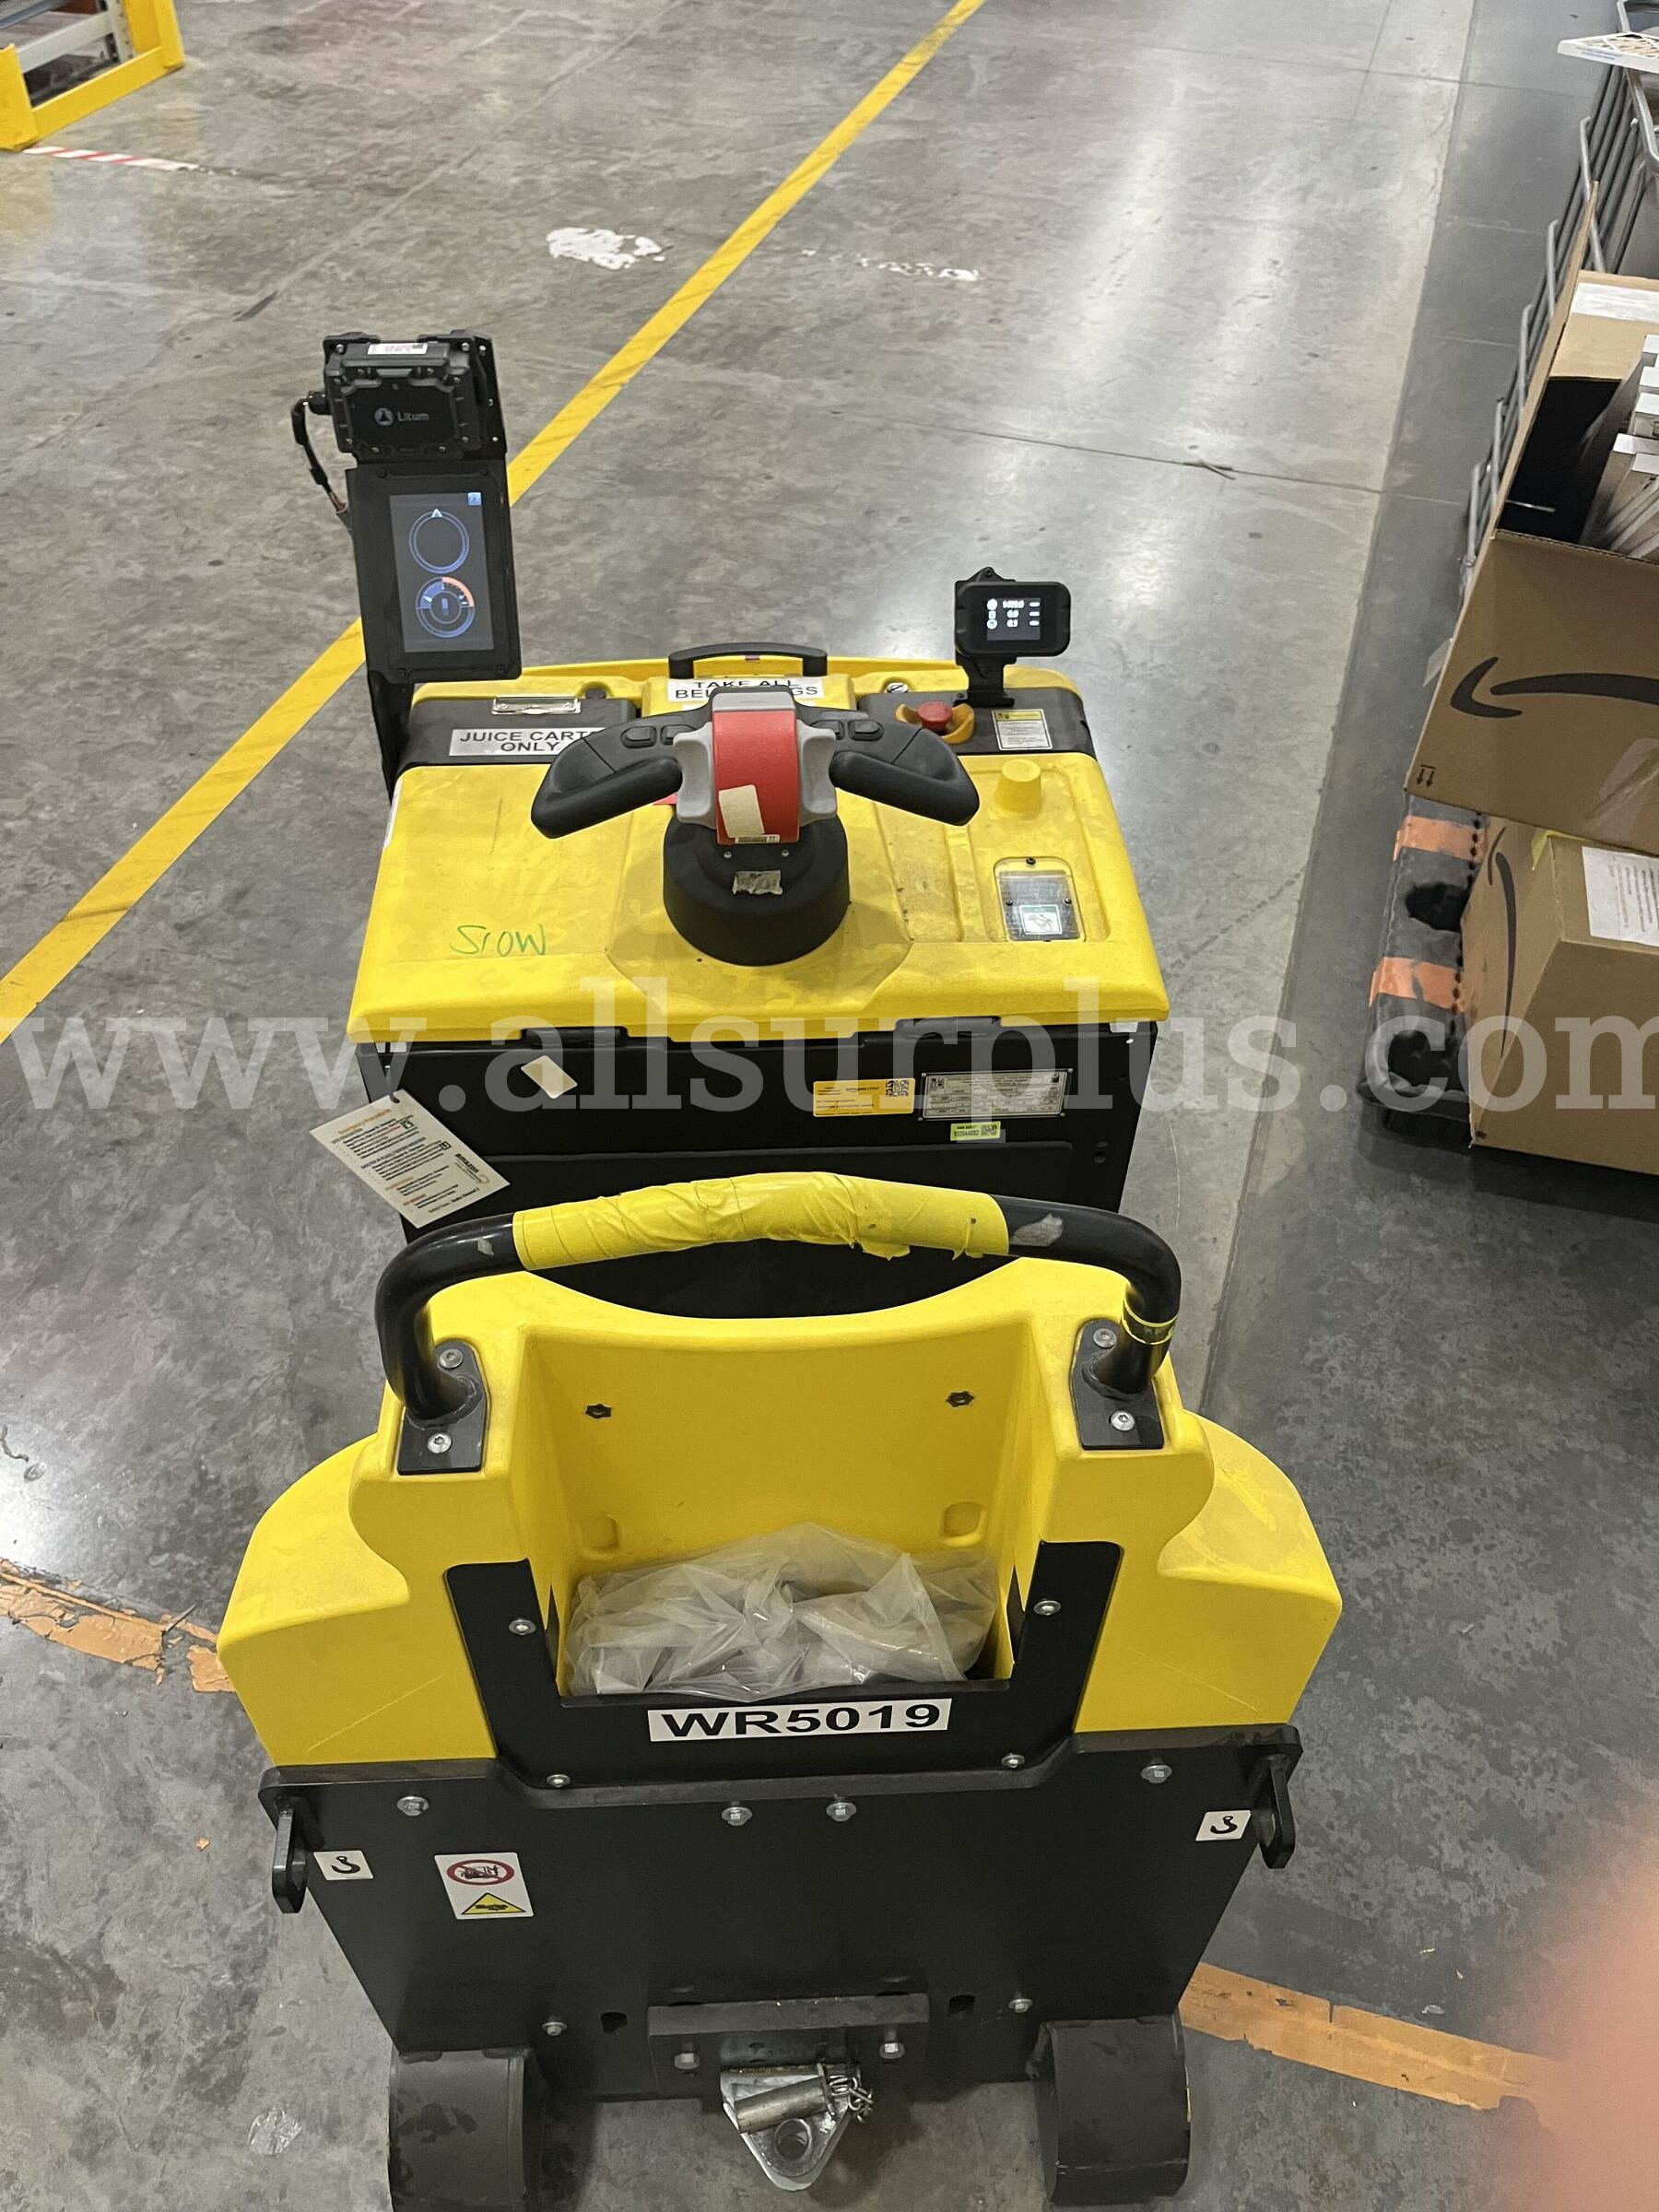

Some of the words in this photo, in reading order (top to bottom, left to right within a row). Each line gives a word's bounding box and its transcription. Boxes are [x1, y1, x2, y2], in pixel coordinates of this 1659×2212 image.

[460, 732, 523, 742] JUICE
[500, 741, 560, 752] ONLY
[661, 1703, 940, 1737] WR5019
